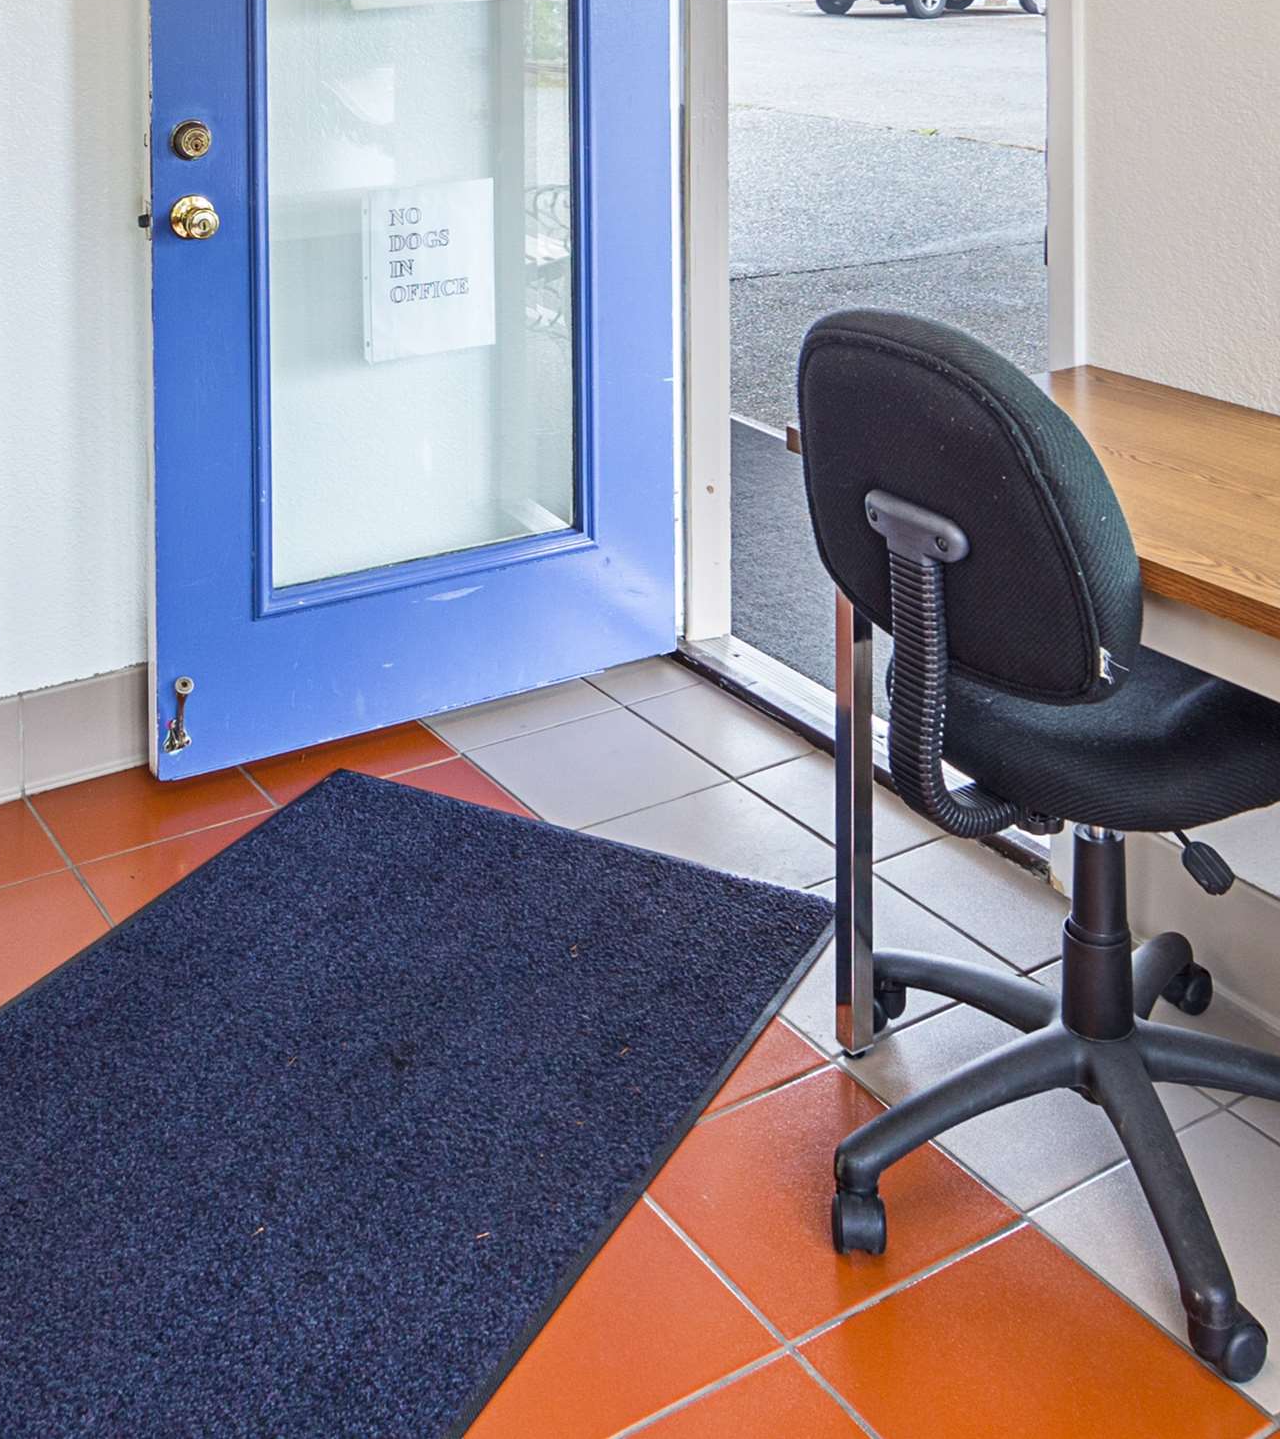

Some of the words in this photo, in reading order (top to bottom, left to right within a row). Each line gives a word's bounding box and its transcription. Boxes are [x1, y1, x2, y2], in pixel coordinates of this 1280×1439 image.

[389, 207, 422, 226] NO
[389, 229, 450, 252] DOGS
[389, 259, 414, 278] IN
[390, 277, 470, 303] OFFICE
